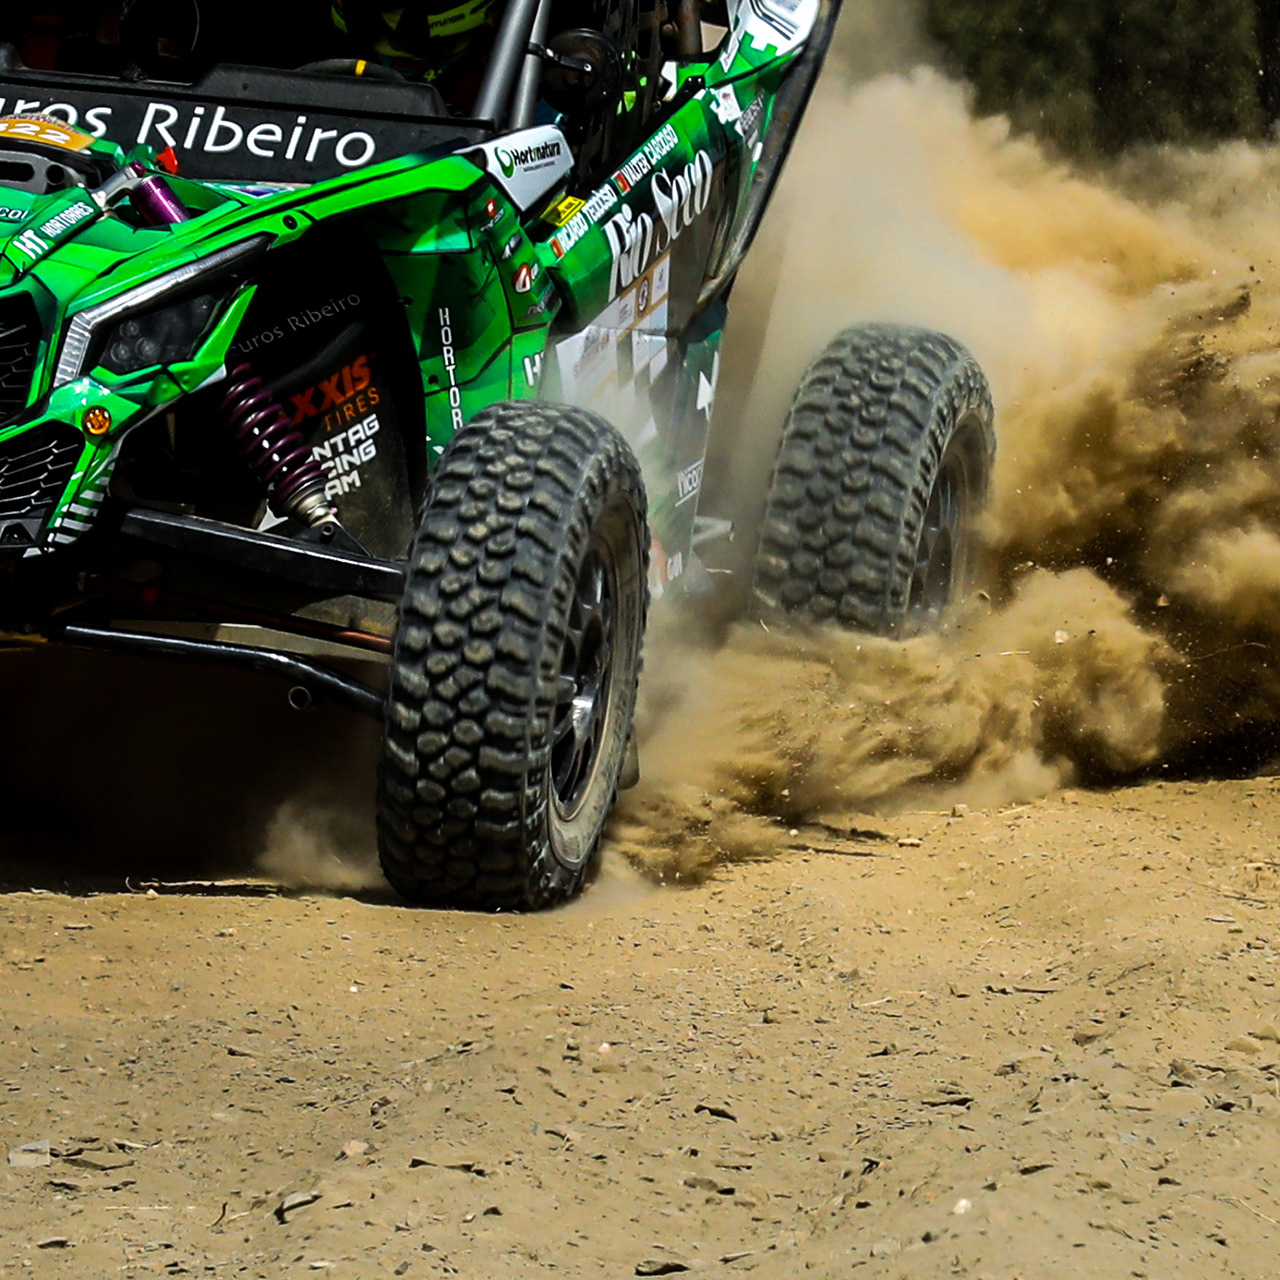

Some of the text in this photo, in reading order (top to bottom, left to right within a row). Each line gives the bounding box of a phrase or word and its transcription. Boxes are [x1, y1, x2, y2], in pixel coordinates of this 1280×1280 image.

[136, 102, 376, 168] Ribeiro
[620, 123, 679, 187] VALTER CARDOSO
[287, 294, 360, 331] Ribeiro
[438, 307, 464, 430] HORTOR
[322, 386, 380, 432] TIRES
